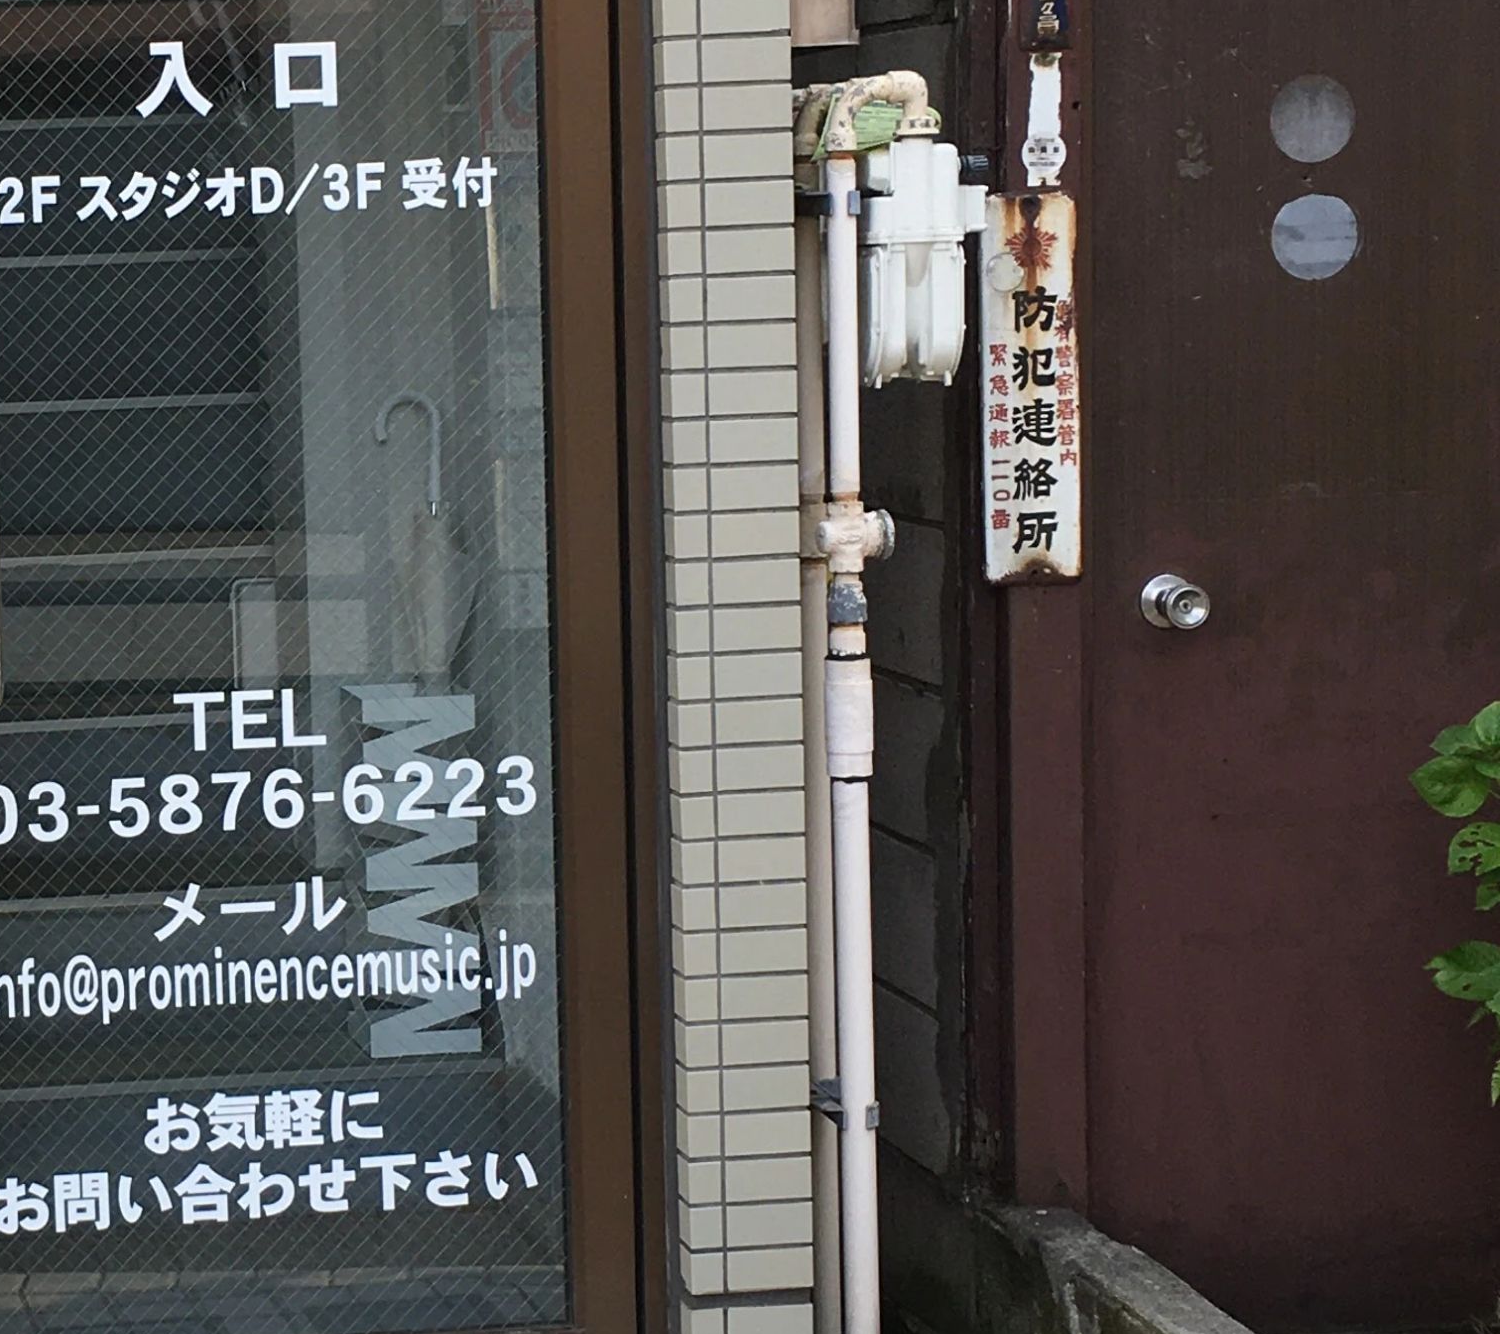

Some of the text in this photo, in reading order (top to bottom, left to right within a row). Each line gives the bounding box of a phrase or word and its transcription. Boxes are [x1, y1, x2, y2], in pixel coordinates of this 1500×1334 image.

[136, 41, 338, 117] 入口
[402, 156, 498, 210] 受付
[1012, 285, 1059, 554] 防犯連絡所
[173, 688, 327, 751] TEL
[154, 876, 347, 942] メール
[144, 1089, 383, 1155] お気軽に
